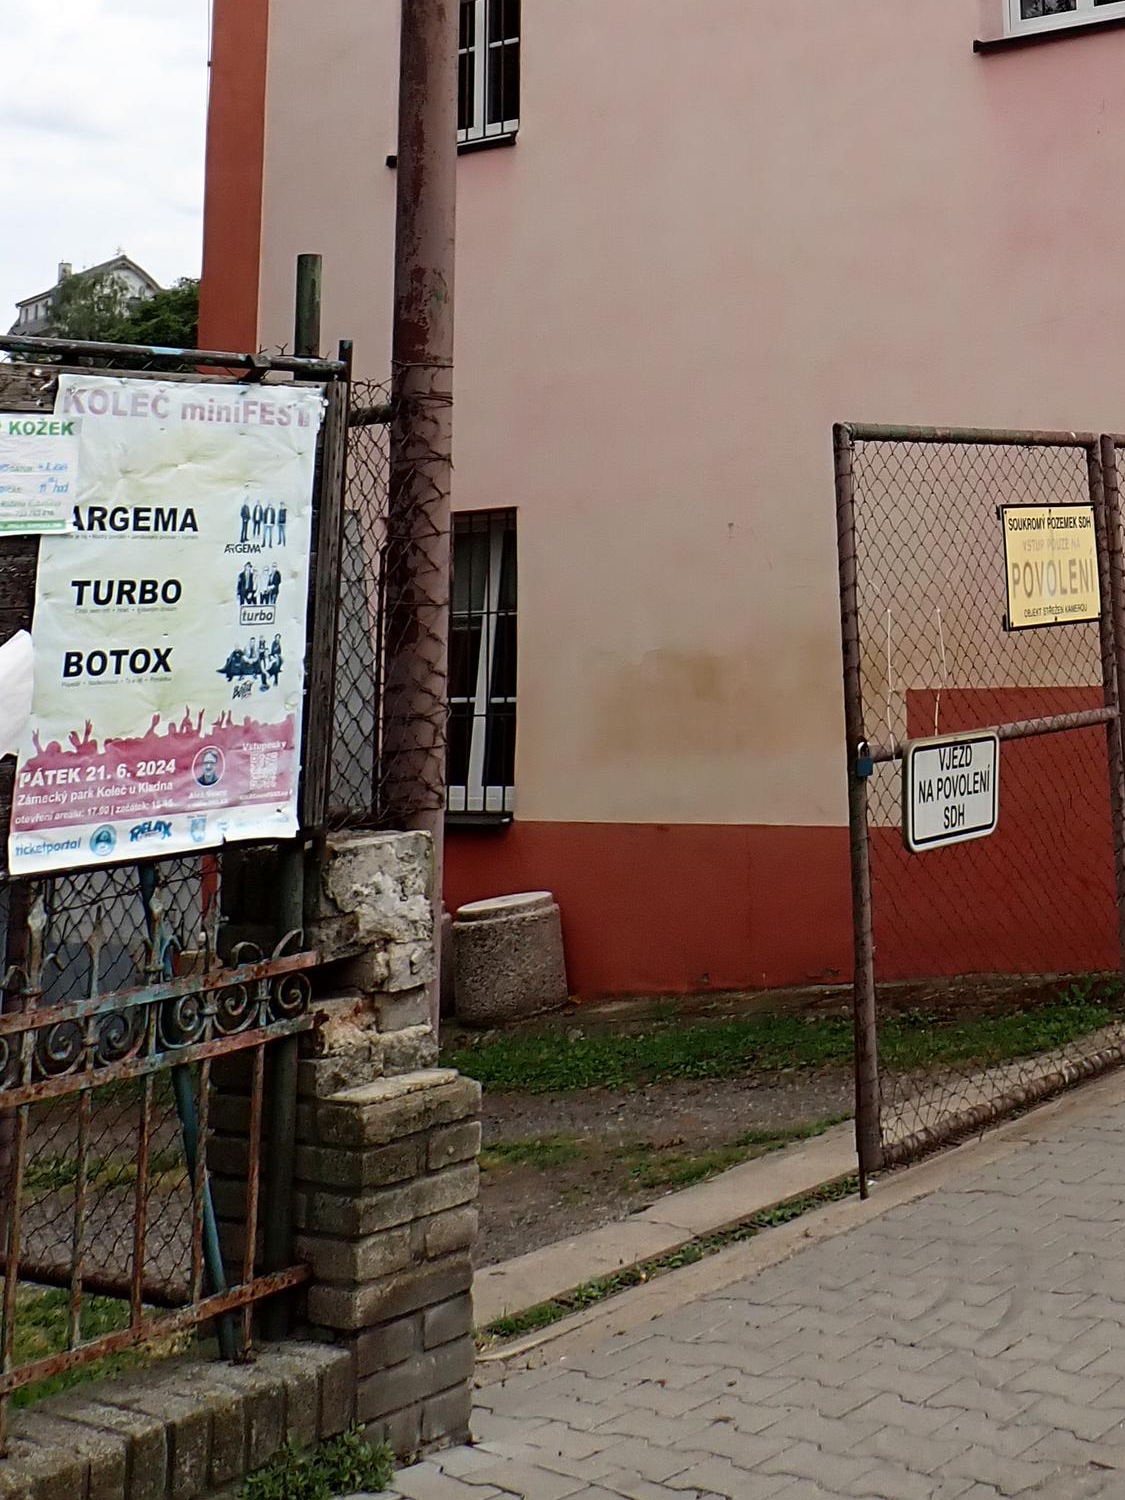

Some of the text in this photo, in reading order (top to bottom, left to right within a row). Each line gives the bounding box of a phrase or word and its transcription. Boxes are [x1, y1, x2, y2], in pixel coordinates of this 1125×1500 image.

[63, 388, 170, 418] KOLEČ
[8, 419, 75, 436] KOŽEK
[73, 505, 199, 532] ARGEMA
[1008, 514, 1092, 531] SOUKROMÝ POZEMEK SDH
[224, 543, 261, 554] ARGEMA
[1023, 539, 1045, 551] VSTUP
[1071, 537, 1081, 548] NA
[1011, 547, 1095, 599] POVOLENÍ
[72, 579, 183, 606] TURBO
[242, 608, 274, 622] turbo
[63, 648, 173, 678] BOTOX
[939, 745, 973, 771] VJEZD
[19, 759, 176, 788] PÁTEK 21. 6. 2024
[918, 764, 991, 804] NA POVOLENÍ
[17, 781, 173, 805] Zámecký park Koleč u Kladna
[943, 804, 965, 829] SDH
[130, 820, 172, 842] RELAX
[15, 837, 81, 856] ticketportal
